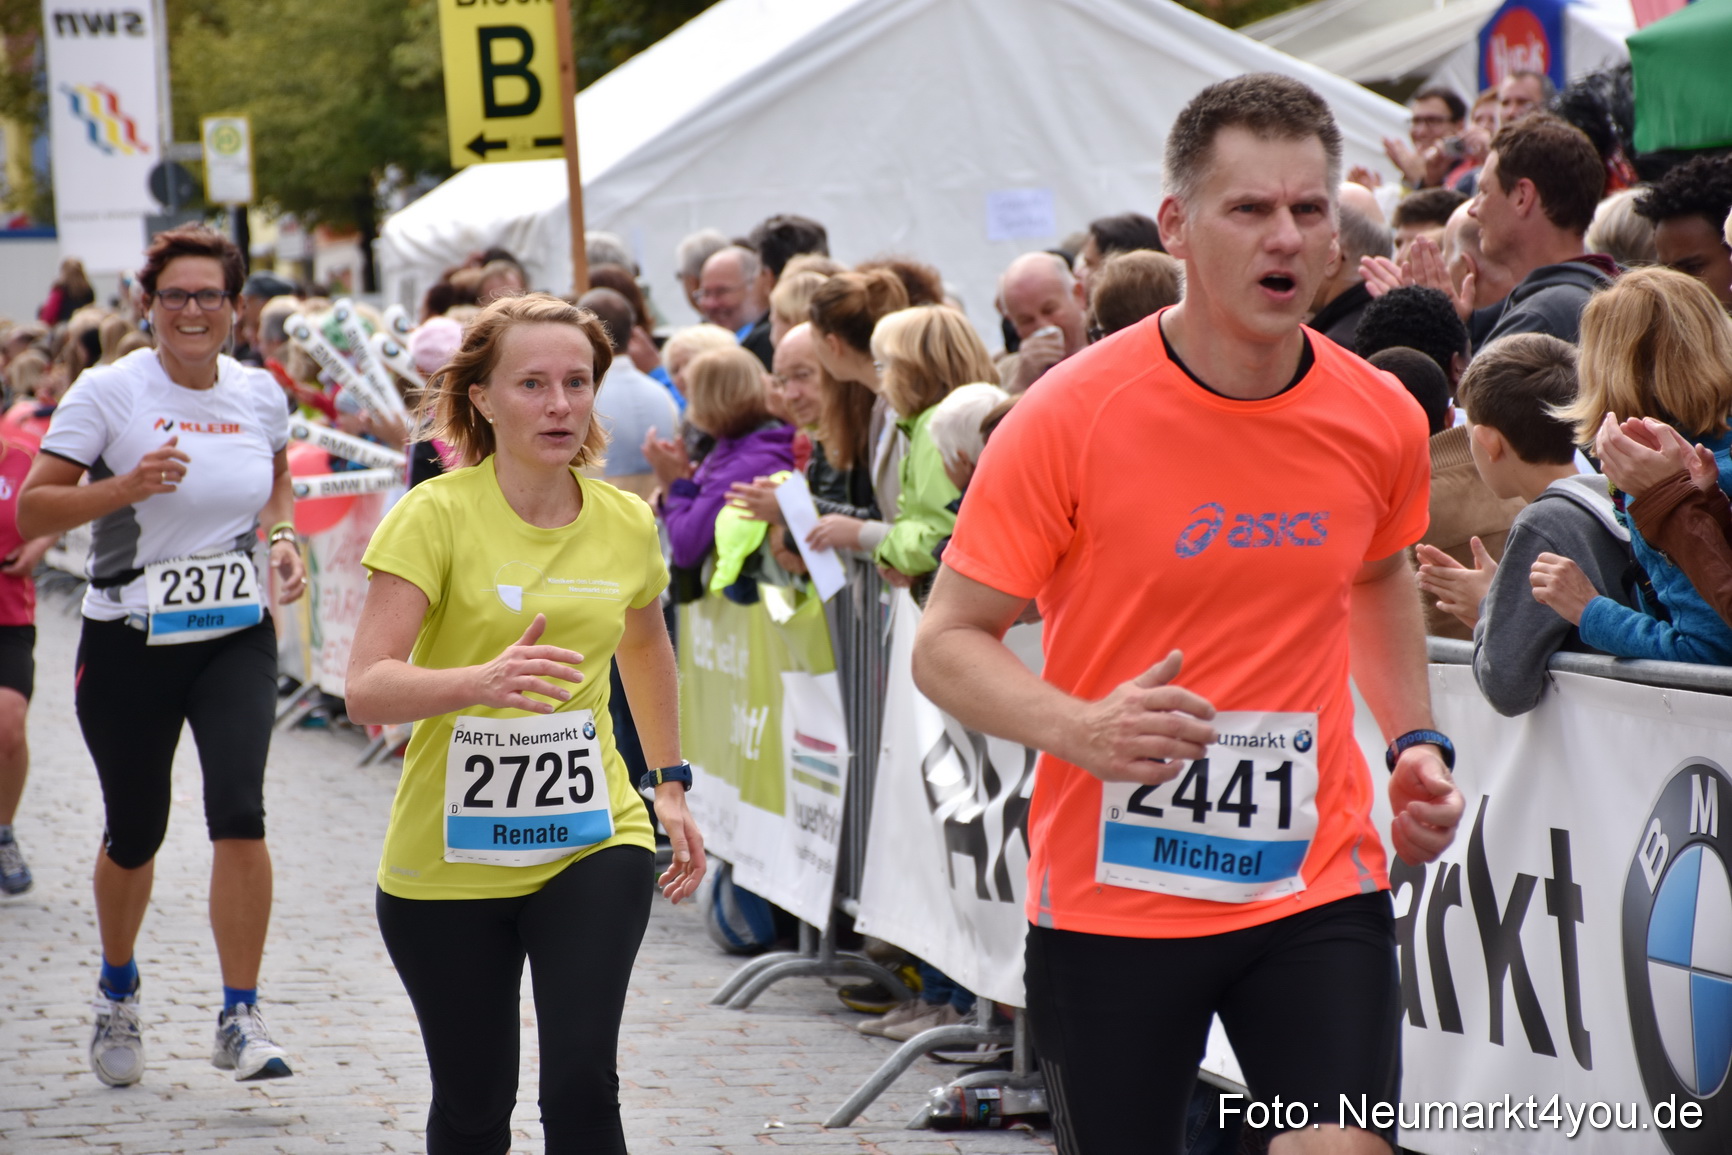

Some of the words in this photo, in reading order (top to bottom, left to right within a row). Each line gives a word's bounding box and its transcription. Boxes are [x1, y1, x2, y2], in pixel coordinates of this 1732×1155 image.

[477, 25, 541, 119] B
[320, 480, 360, 496] BMW
[1227, 512, 1331, 548] asics
[160, 562, 250, 607] 2372
[187, 613, 225, 628] Petra
[454, 729, 505, 747] PARTL
[509, 727, 578, 747] Neumarkt
[1217, 731, 1287, 749] umarkt
[463, 748, 594, 808] 2725
[1126, 757, 1293, 830] 2441
[451, 803, 459, 815] D
[1111, 807, 1120, 820] D
[493, 823, 569, 845] Renate
[1153, 836, 1263, 876] Michael
[1389, 794, 1593, 1072] arkt
